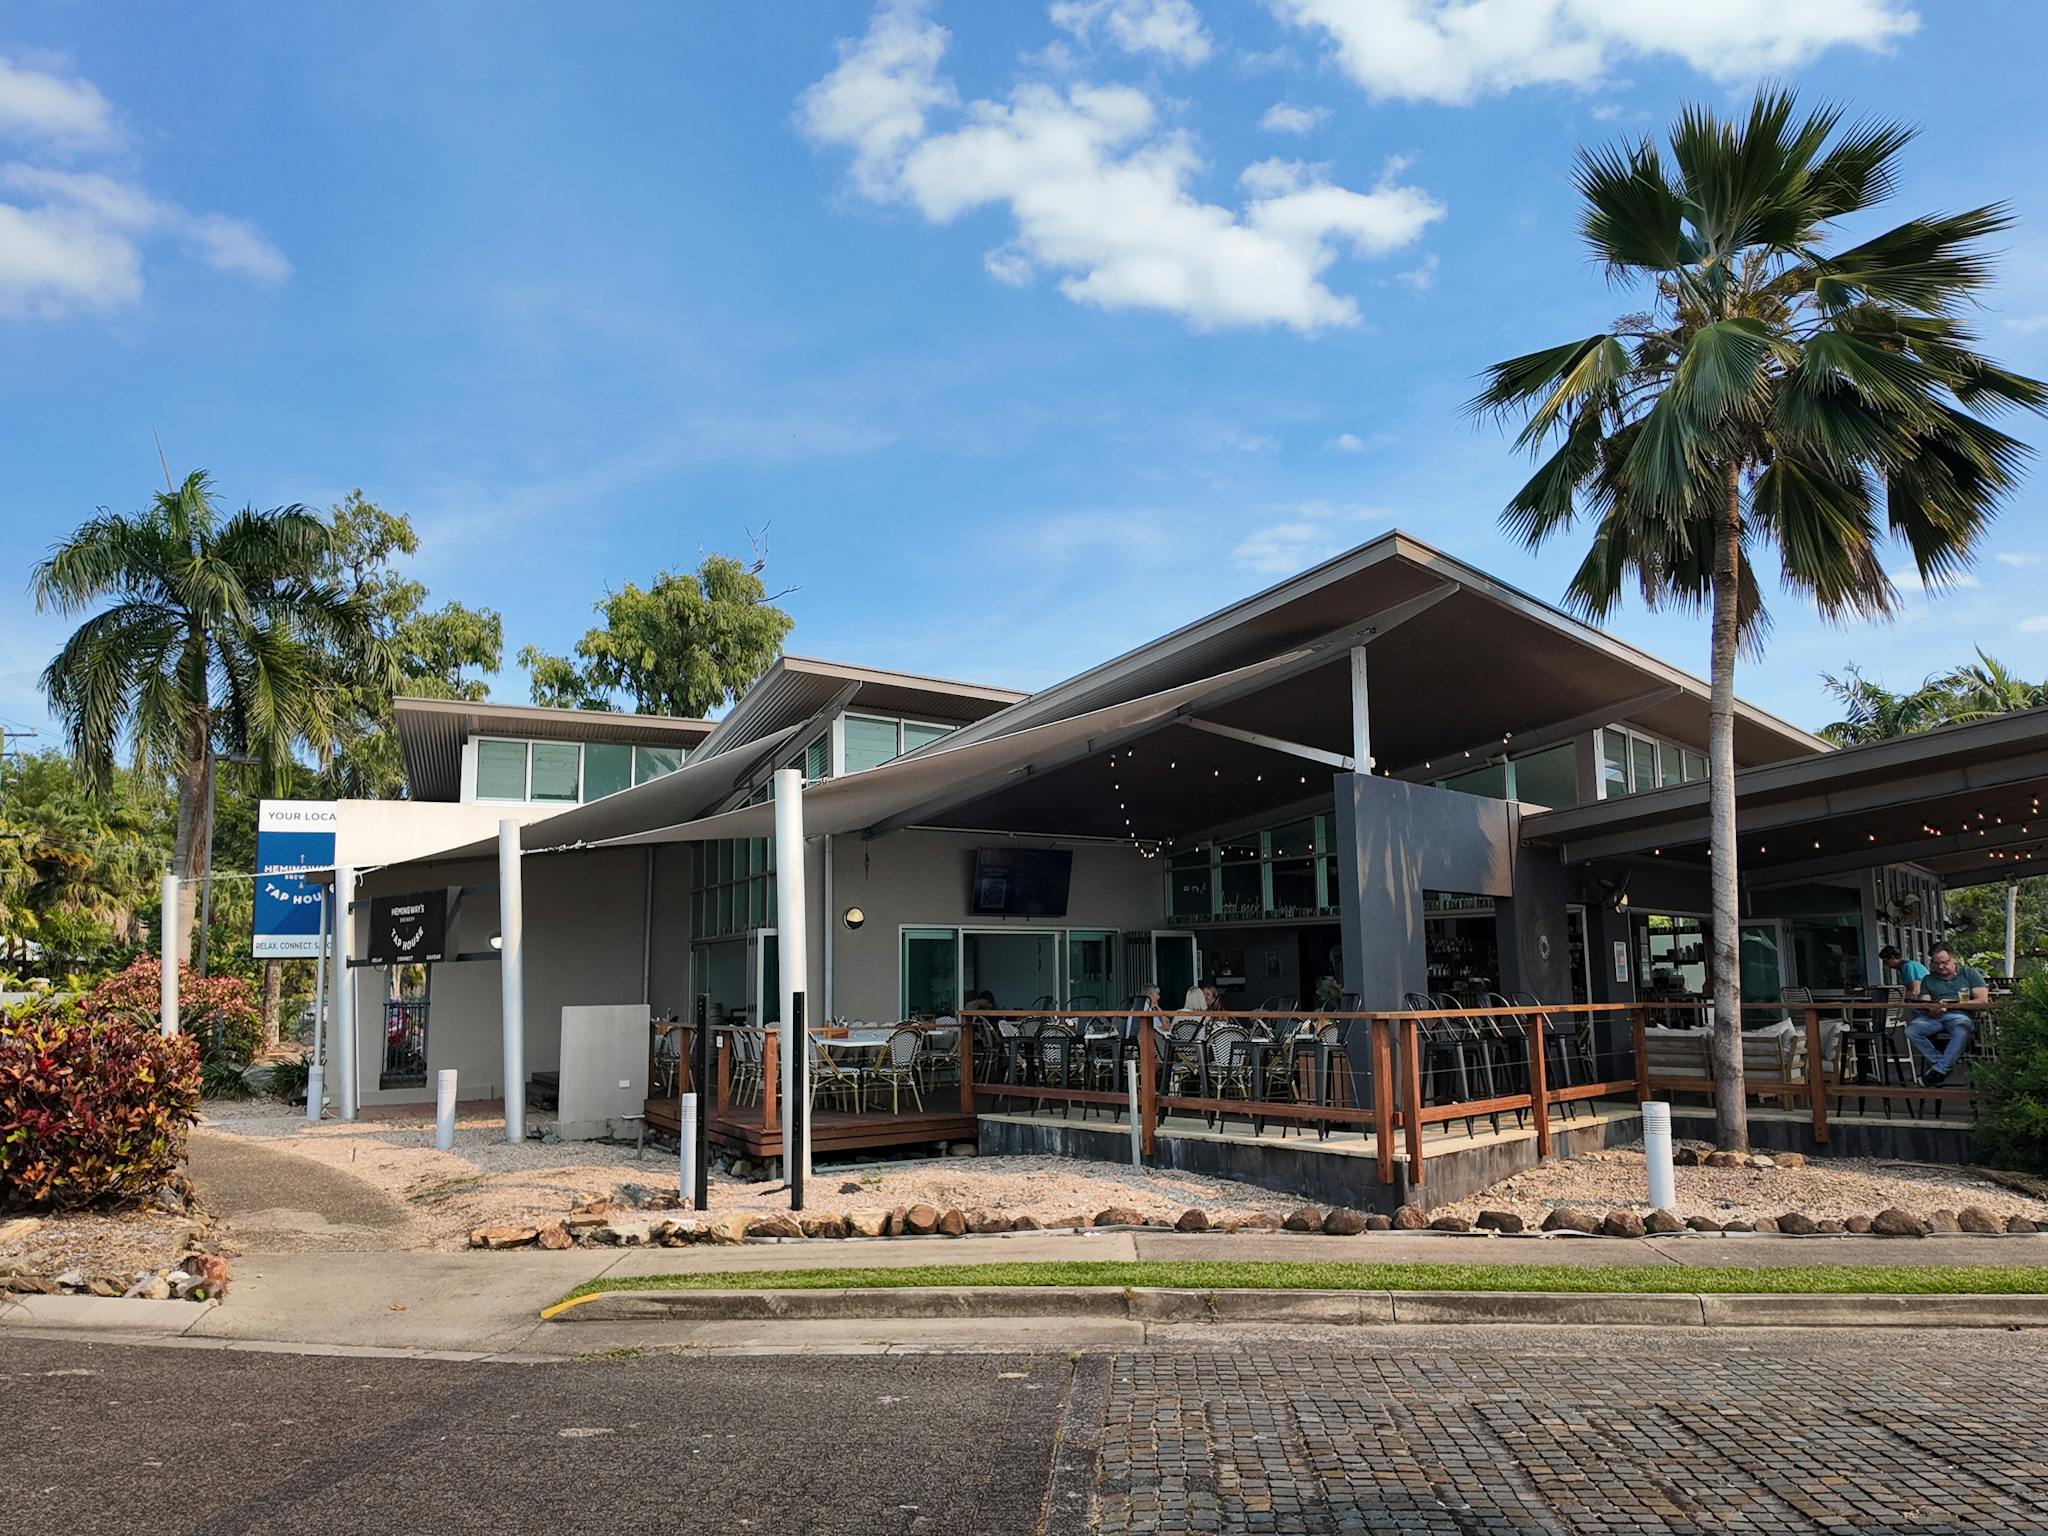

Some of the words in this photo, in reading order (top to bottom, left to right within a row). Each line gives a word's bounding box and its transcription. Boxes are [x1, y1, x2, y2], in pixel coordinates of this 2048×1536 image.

[268, 812, 301, 821] YOUR
[305, 812, 337, 821] LOCA
[265, 883, 289, 901] TAP
[391, 928, 402, 947] TAP
[402, 926, 424, 951] HOUSE
